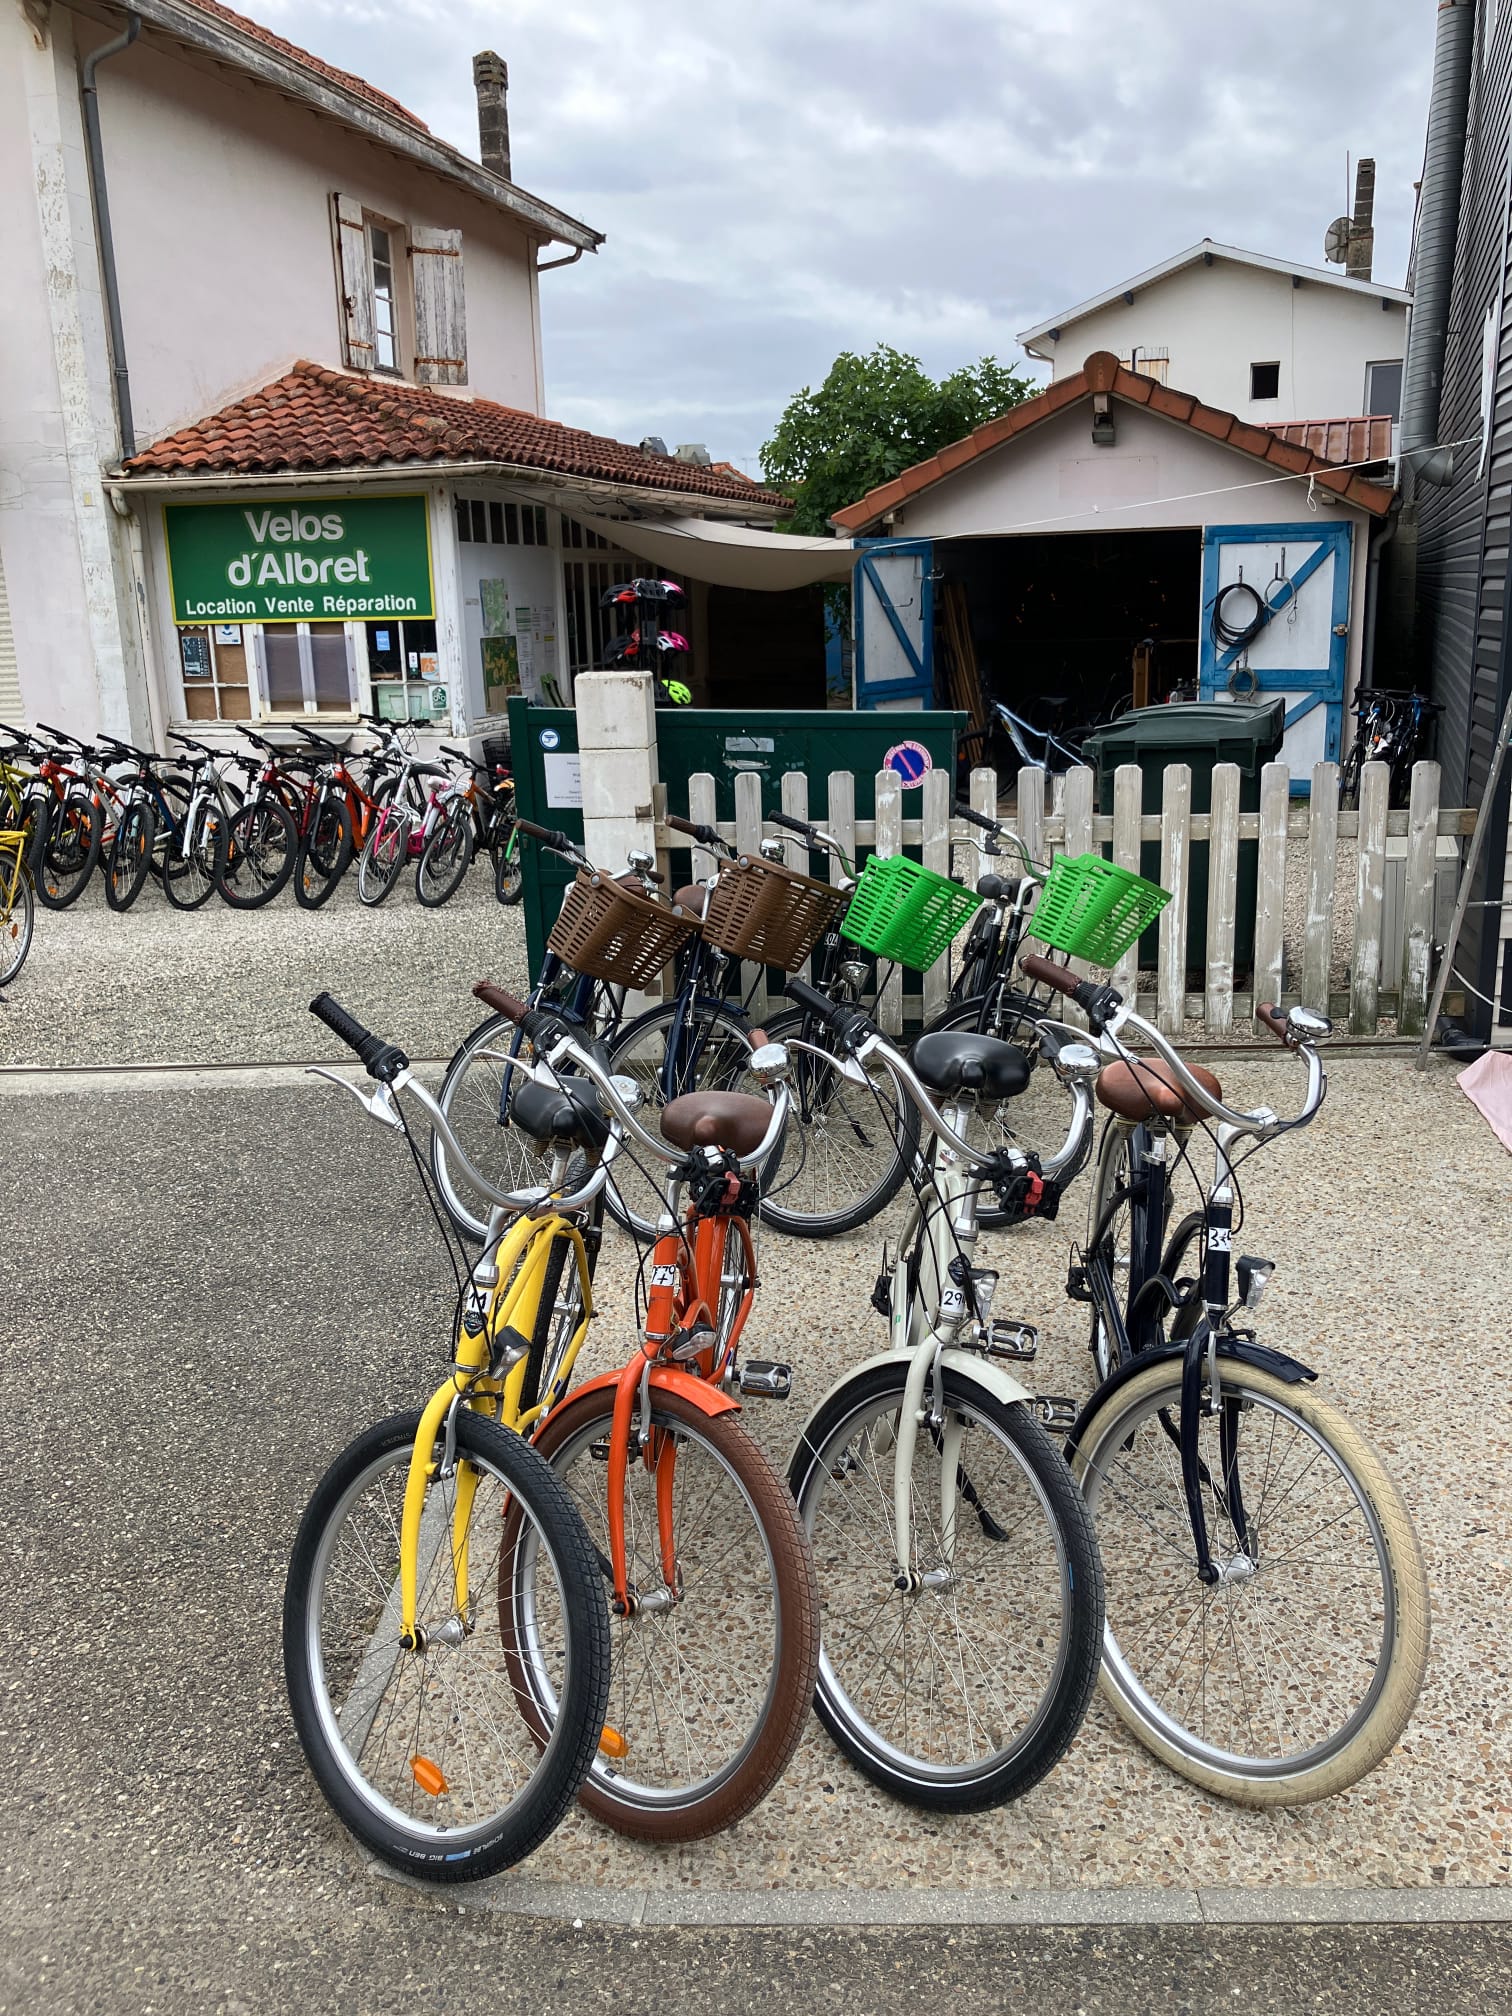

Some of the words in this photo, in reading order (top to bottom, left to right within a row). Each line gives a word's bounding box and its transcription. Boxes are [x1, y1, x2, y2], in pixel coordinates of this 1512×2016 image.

[243, 509, 344, 543] Velos
[227, 549, 370, 587] d'Albret
[186, 597, 257, 616] Location
[264, 596, 314, 613] Vente
[323, 594, 417, 616] Réparation
